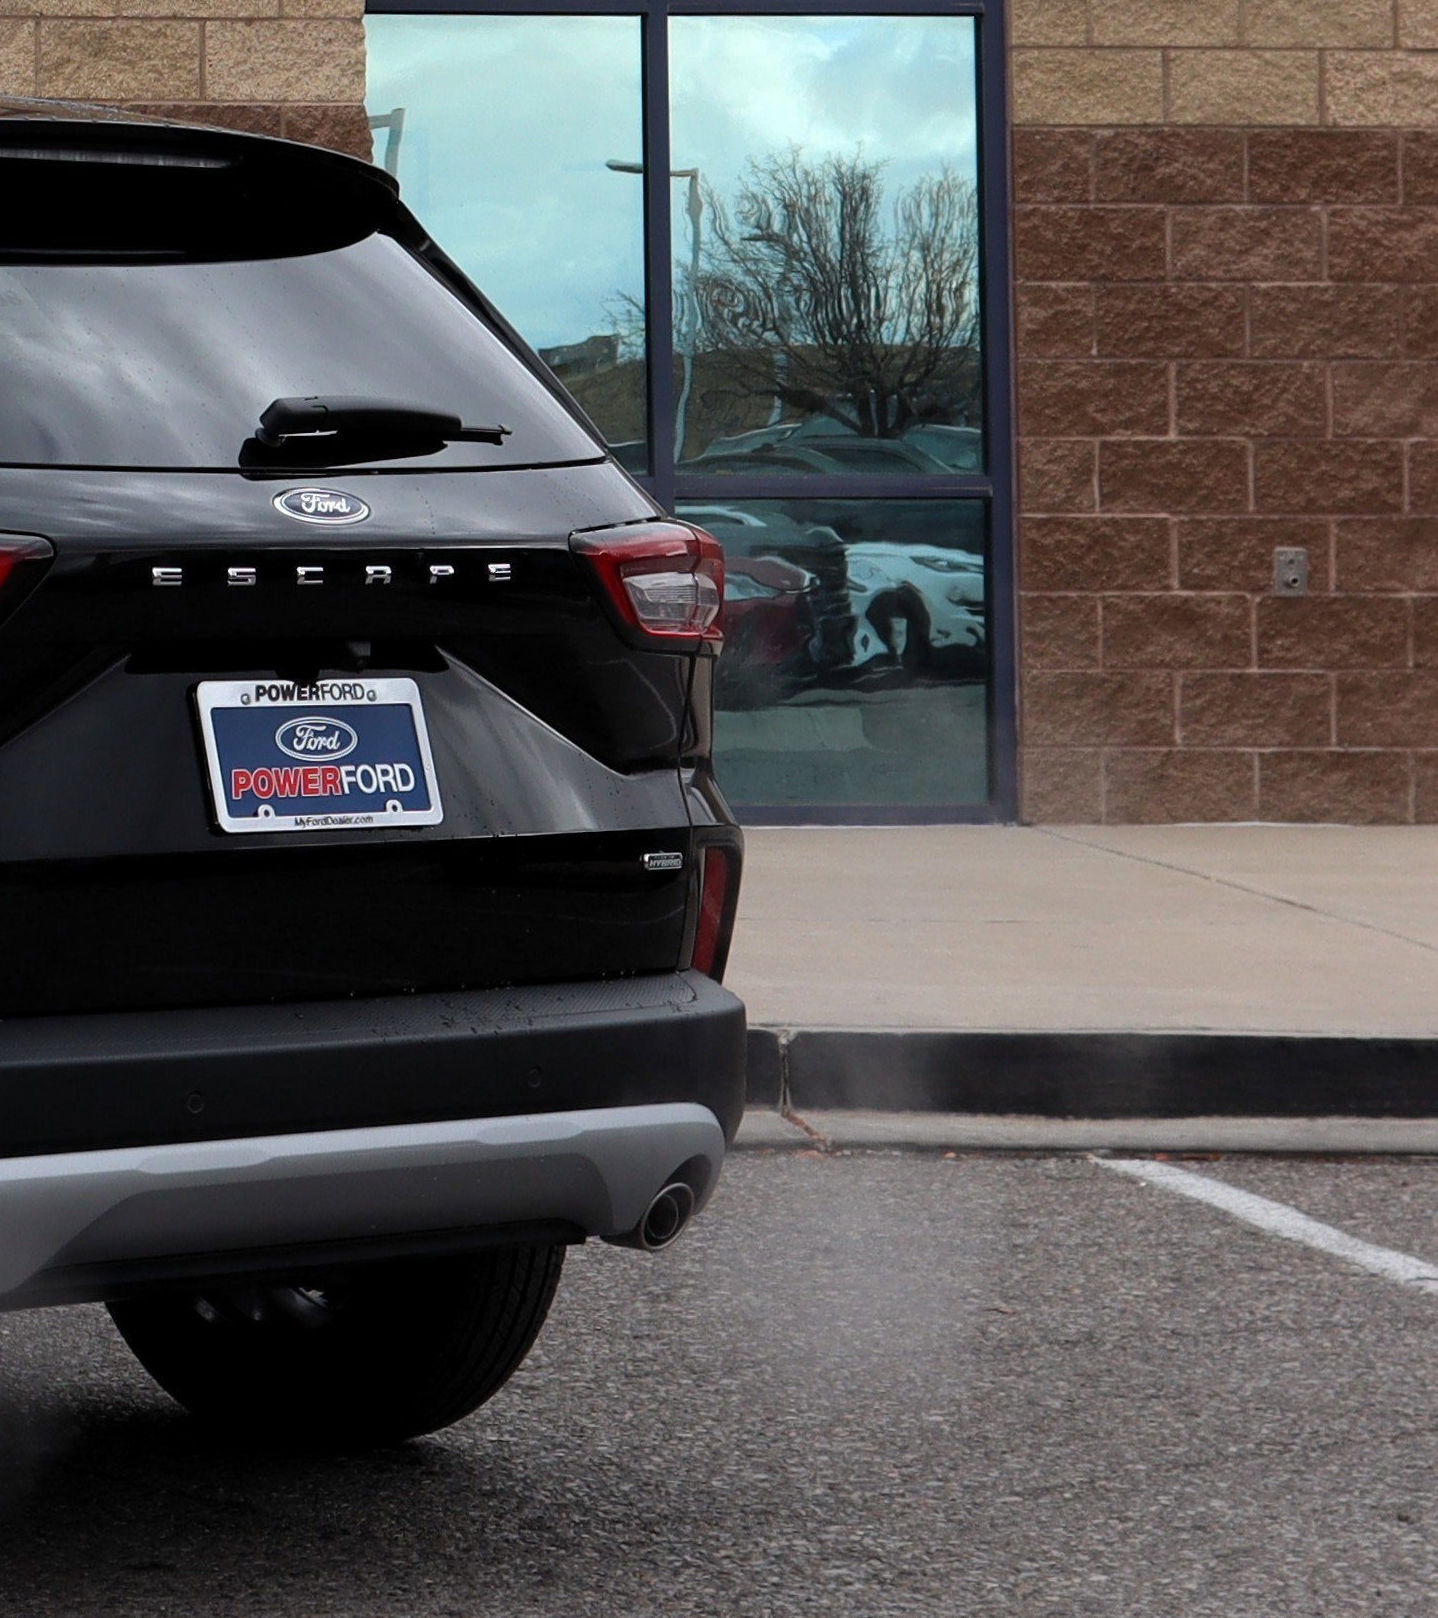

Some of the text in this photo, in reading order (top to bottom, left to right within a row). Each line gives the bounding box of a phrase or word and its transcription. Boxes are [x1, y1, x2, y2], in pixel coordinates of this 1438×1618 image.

[299, 491, 352, 515] Ford
[151, 562, 512, 585] ESCAPE
[254, 683, 365, 703] POWERFORD
[292, 724, 341, 751] Ford
[231, 763, 415, 800] POWERFORD
[293, 815, 374, 828] MyFordDealer.com
